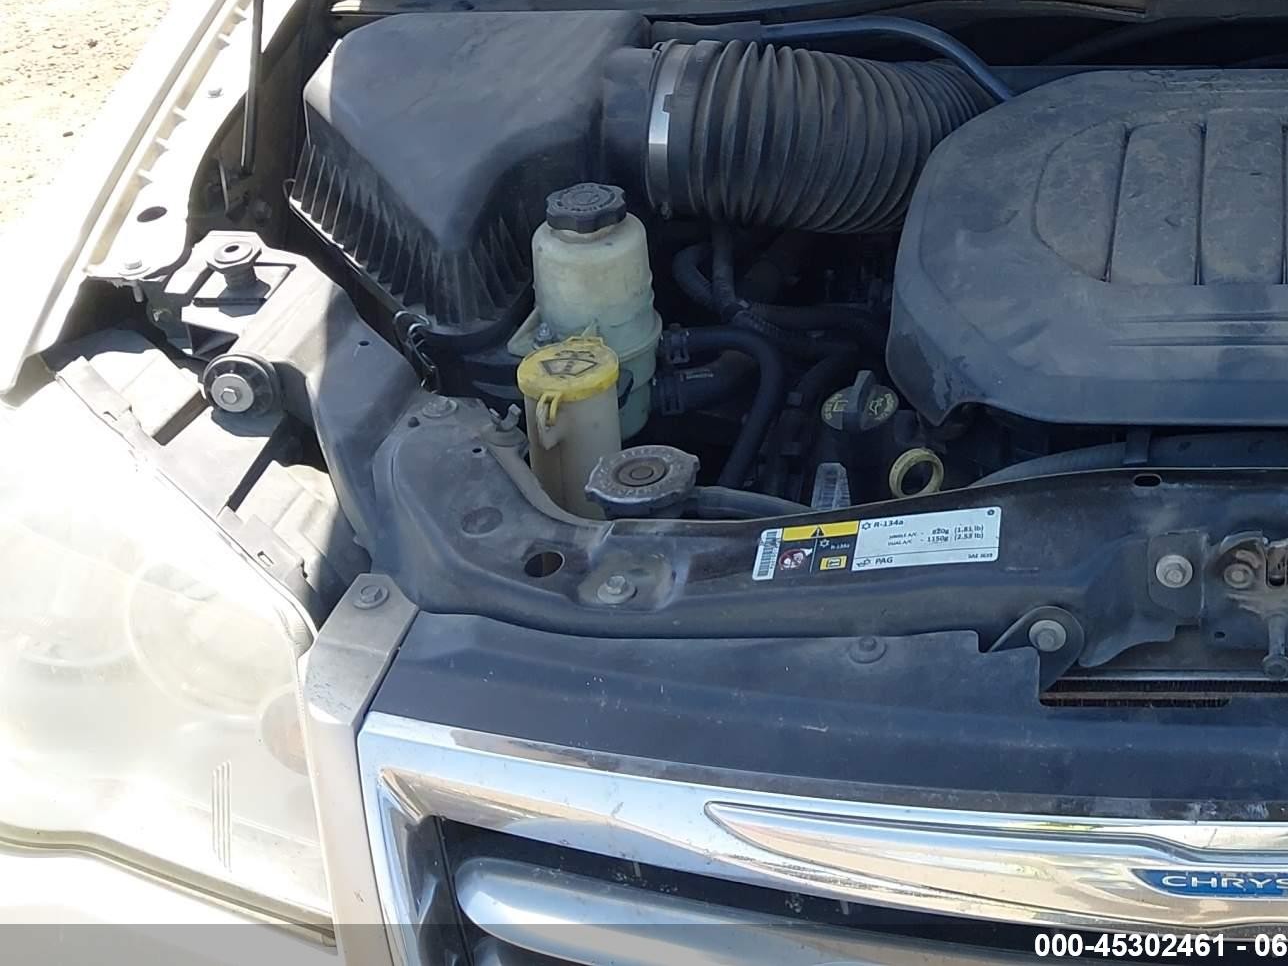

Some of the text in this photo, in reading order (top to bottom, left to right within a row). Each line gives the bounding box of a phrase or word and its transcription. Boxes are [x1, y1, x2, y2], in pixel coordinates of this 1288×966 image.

[873, 519, 904, 528] R-134a
[927, 534, 949, 543] 1150g
[875, 556, 893, 564] PAG
